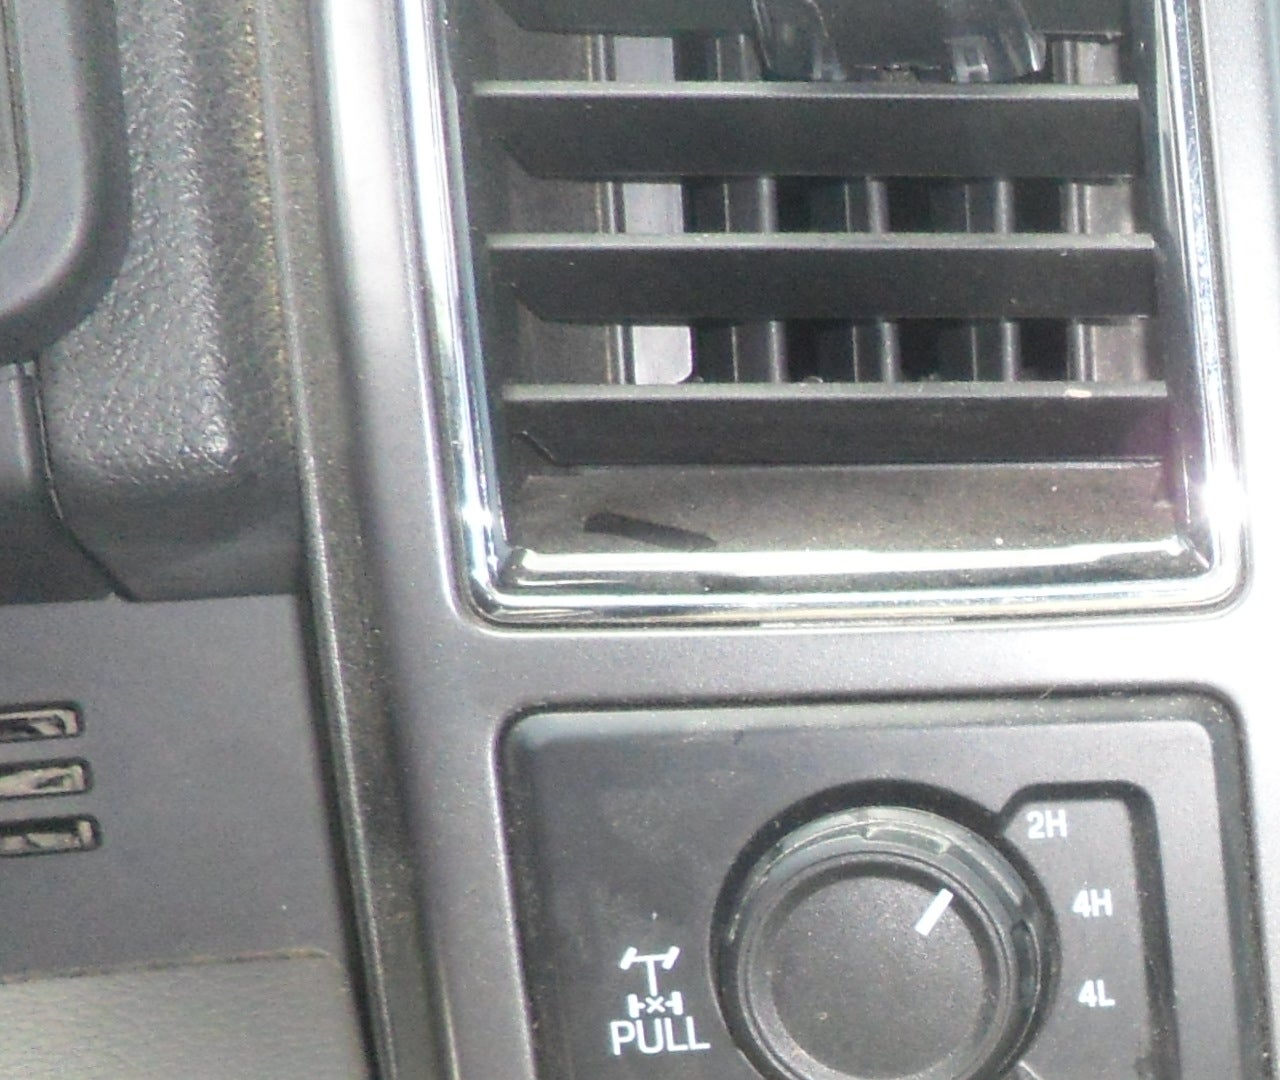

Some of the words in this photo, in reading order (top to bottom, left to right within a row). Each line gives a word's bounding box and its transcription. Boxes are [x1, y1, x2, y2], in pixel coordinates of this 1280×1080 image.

[1026, 810, 1068, 840] 2H
[1072, 889, 1113, 919] 4H
[1076, 979, 1116, 1009] 4L
[610, 1016, 711, 1056] PULL
